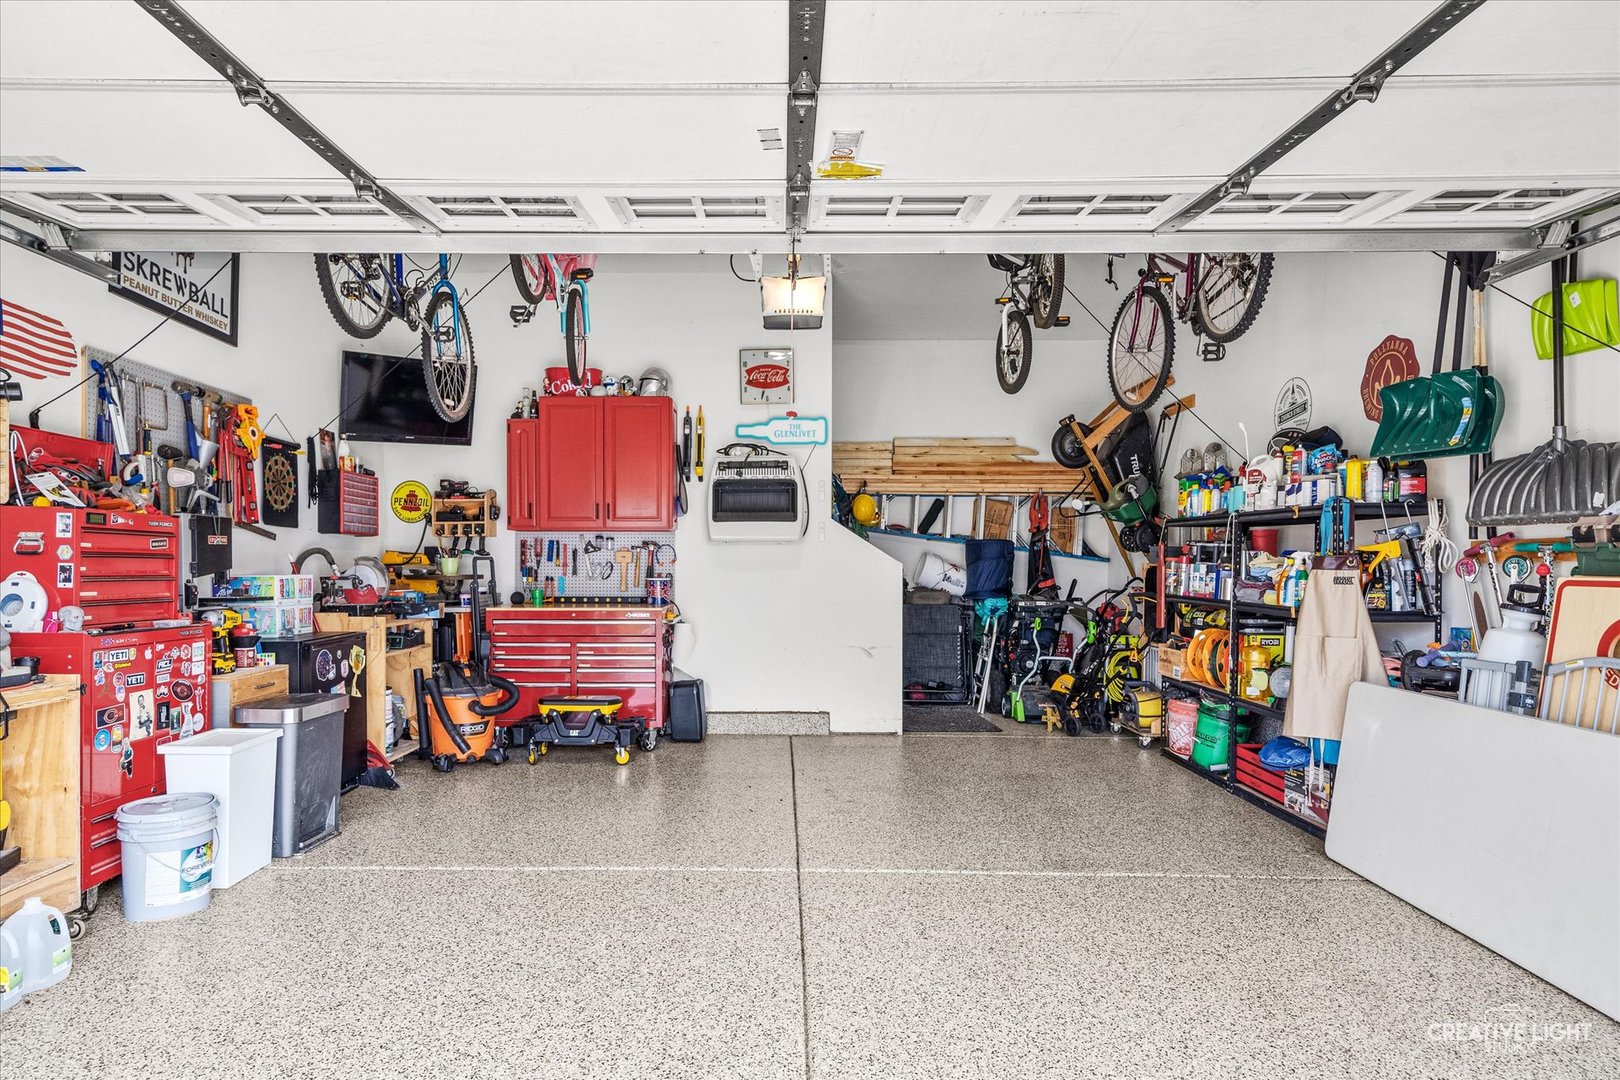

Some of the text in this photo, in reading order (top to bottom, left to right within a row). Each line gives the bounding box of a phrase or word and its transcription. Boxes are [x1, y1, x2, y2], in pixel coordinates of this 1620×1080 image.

[123, 251, 229, 319] SKREWBALL
[123, 274, 229, 331] PEANUT BUTTER WHISKEY
[1369, 339, 1408, 366] POLLYANNA
[749, 368, 785, 383] Coca-Cola
[1363, 388, 1381, 419] BREWING
[774, 430, 817, 438] GLENLIVET
[1130, 454, 1141, 477] TRU
[394, 497, 430, 507] PENNZOIL
[110, 651, 128, 660] YETI
[126, 674, 144, 684] YETI
